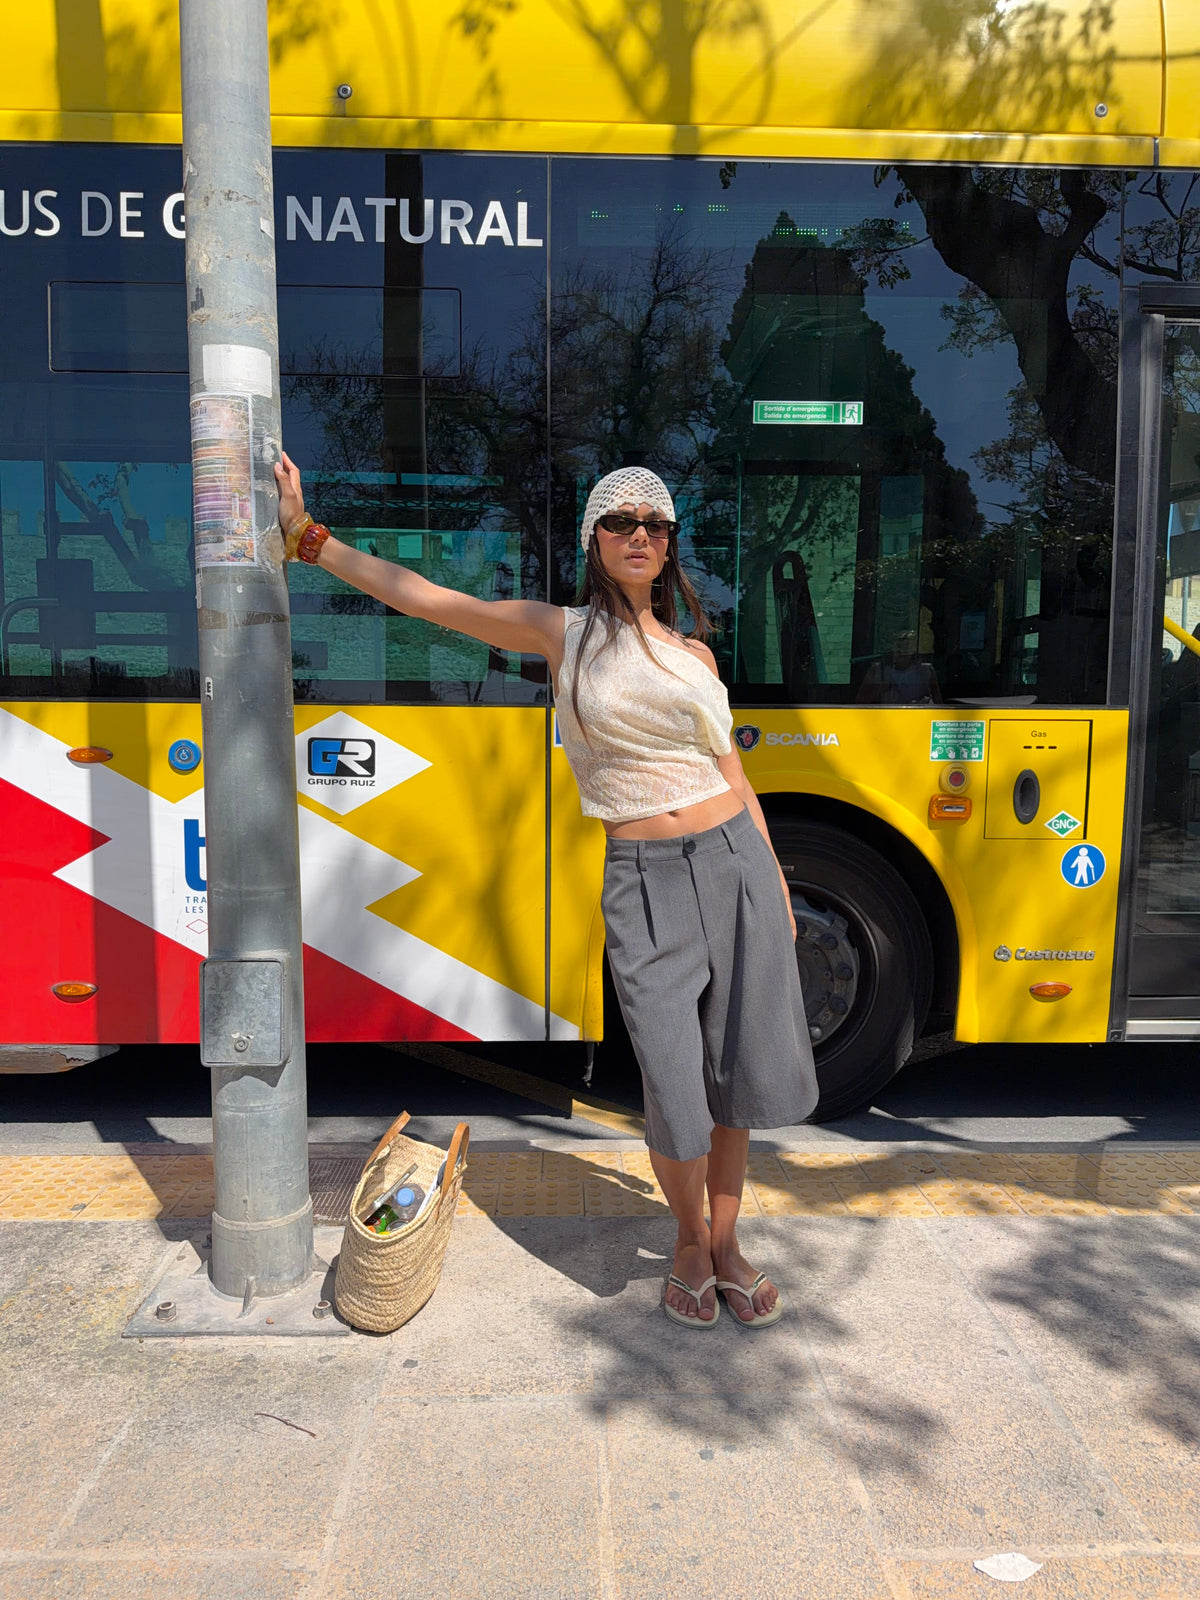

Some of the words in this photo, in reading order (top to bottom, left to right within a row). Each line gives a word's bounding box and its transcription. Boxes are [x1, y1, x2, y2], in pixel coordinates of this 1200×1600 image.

[81, 191, 144, 238] DE
[286, 195, 544, 247] NATURAL
[765, 733, 840, 746] SCANIA
[1030, 730, 1047, 738] Gas
[311, 740, 373, 775] GR
[351, 779, 376, 787] RUIZ
[1051, 819, 1074, 830] GNC
[1015, 947, 1096, 961] Castrosua
